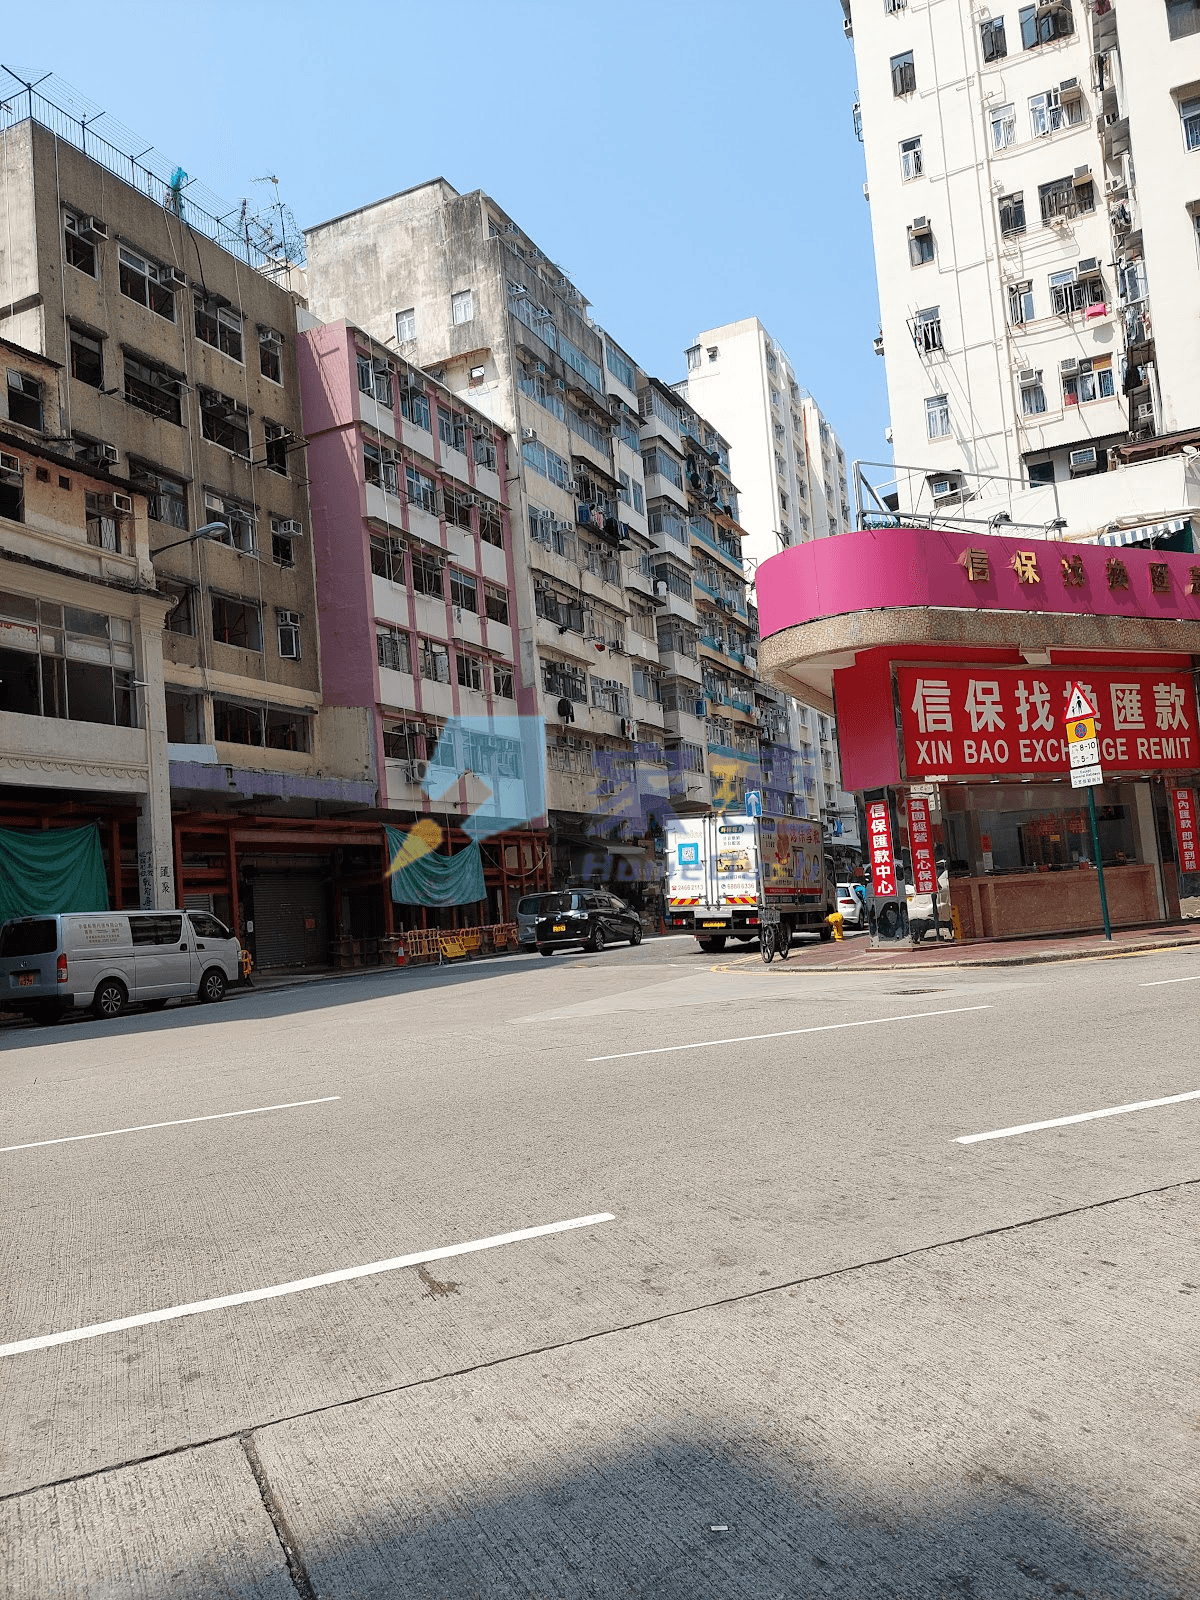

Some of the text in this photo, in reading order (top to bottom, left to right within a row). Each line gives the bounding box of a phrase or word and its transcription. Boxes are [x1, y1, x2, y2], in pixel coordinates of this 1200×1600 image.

[916, 737, 1190, 764] XIN BAO EXCHGE REMIT
[1080, 741, 1095, 751] 8-10
[1081, 753, 1094, 763] 5-7
[870, 803, 894, 894] 信保匯款中心
[915, 848, 934, 892] 信心保證
